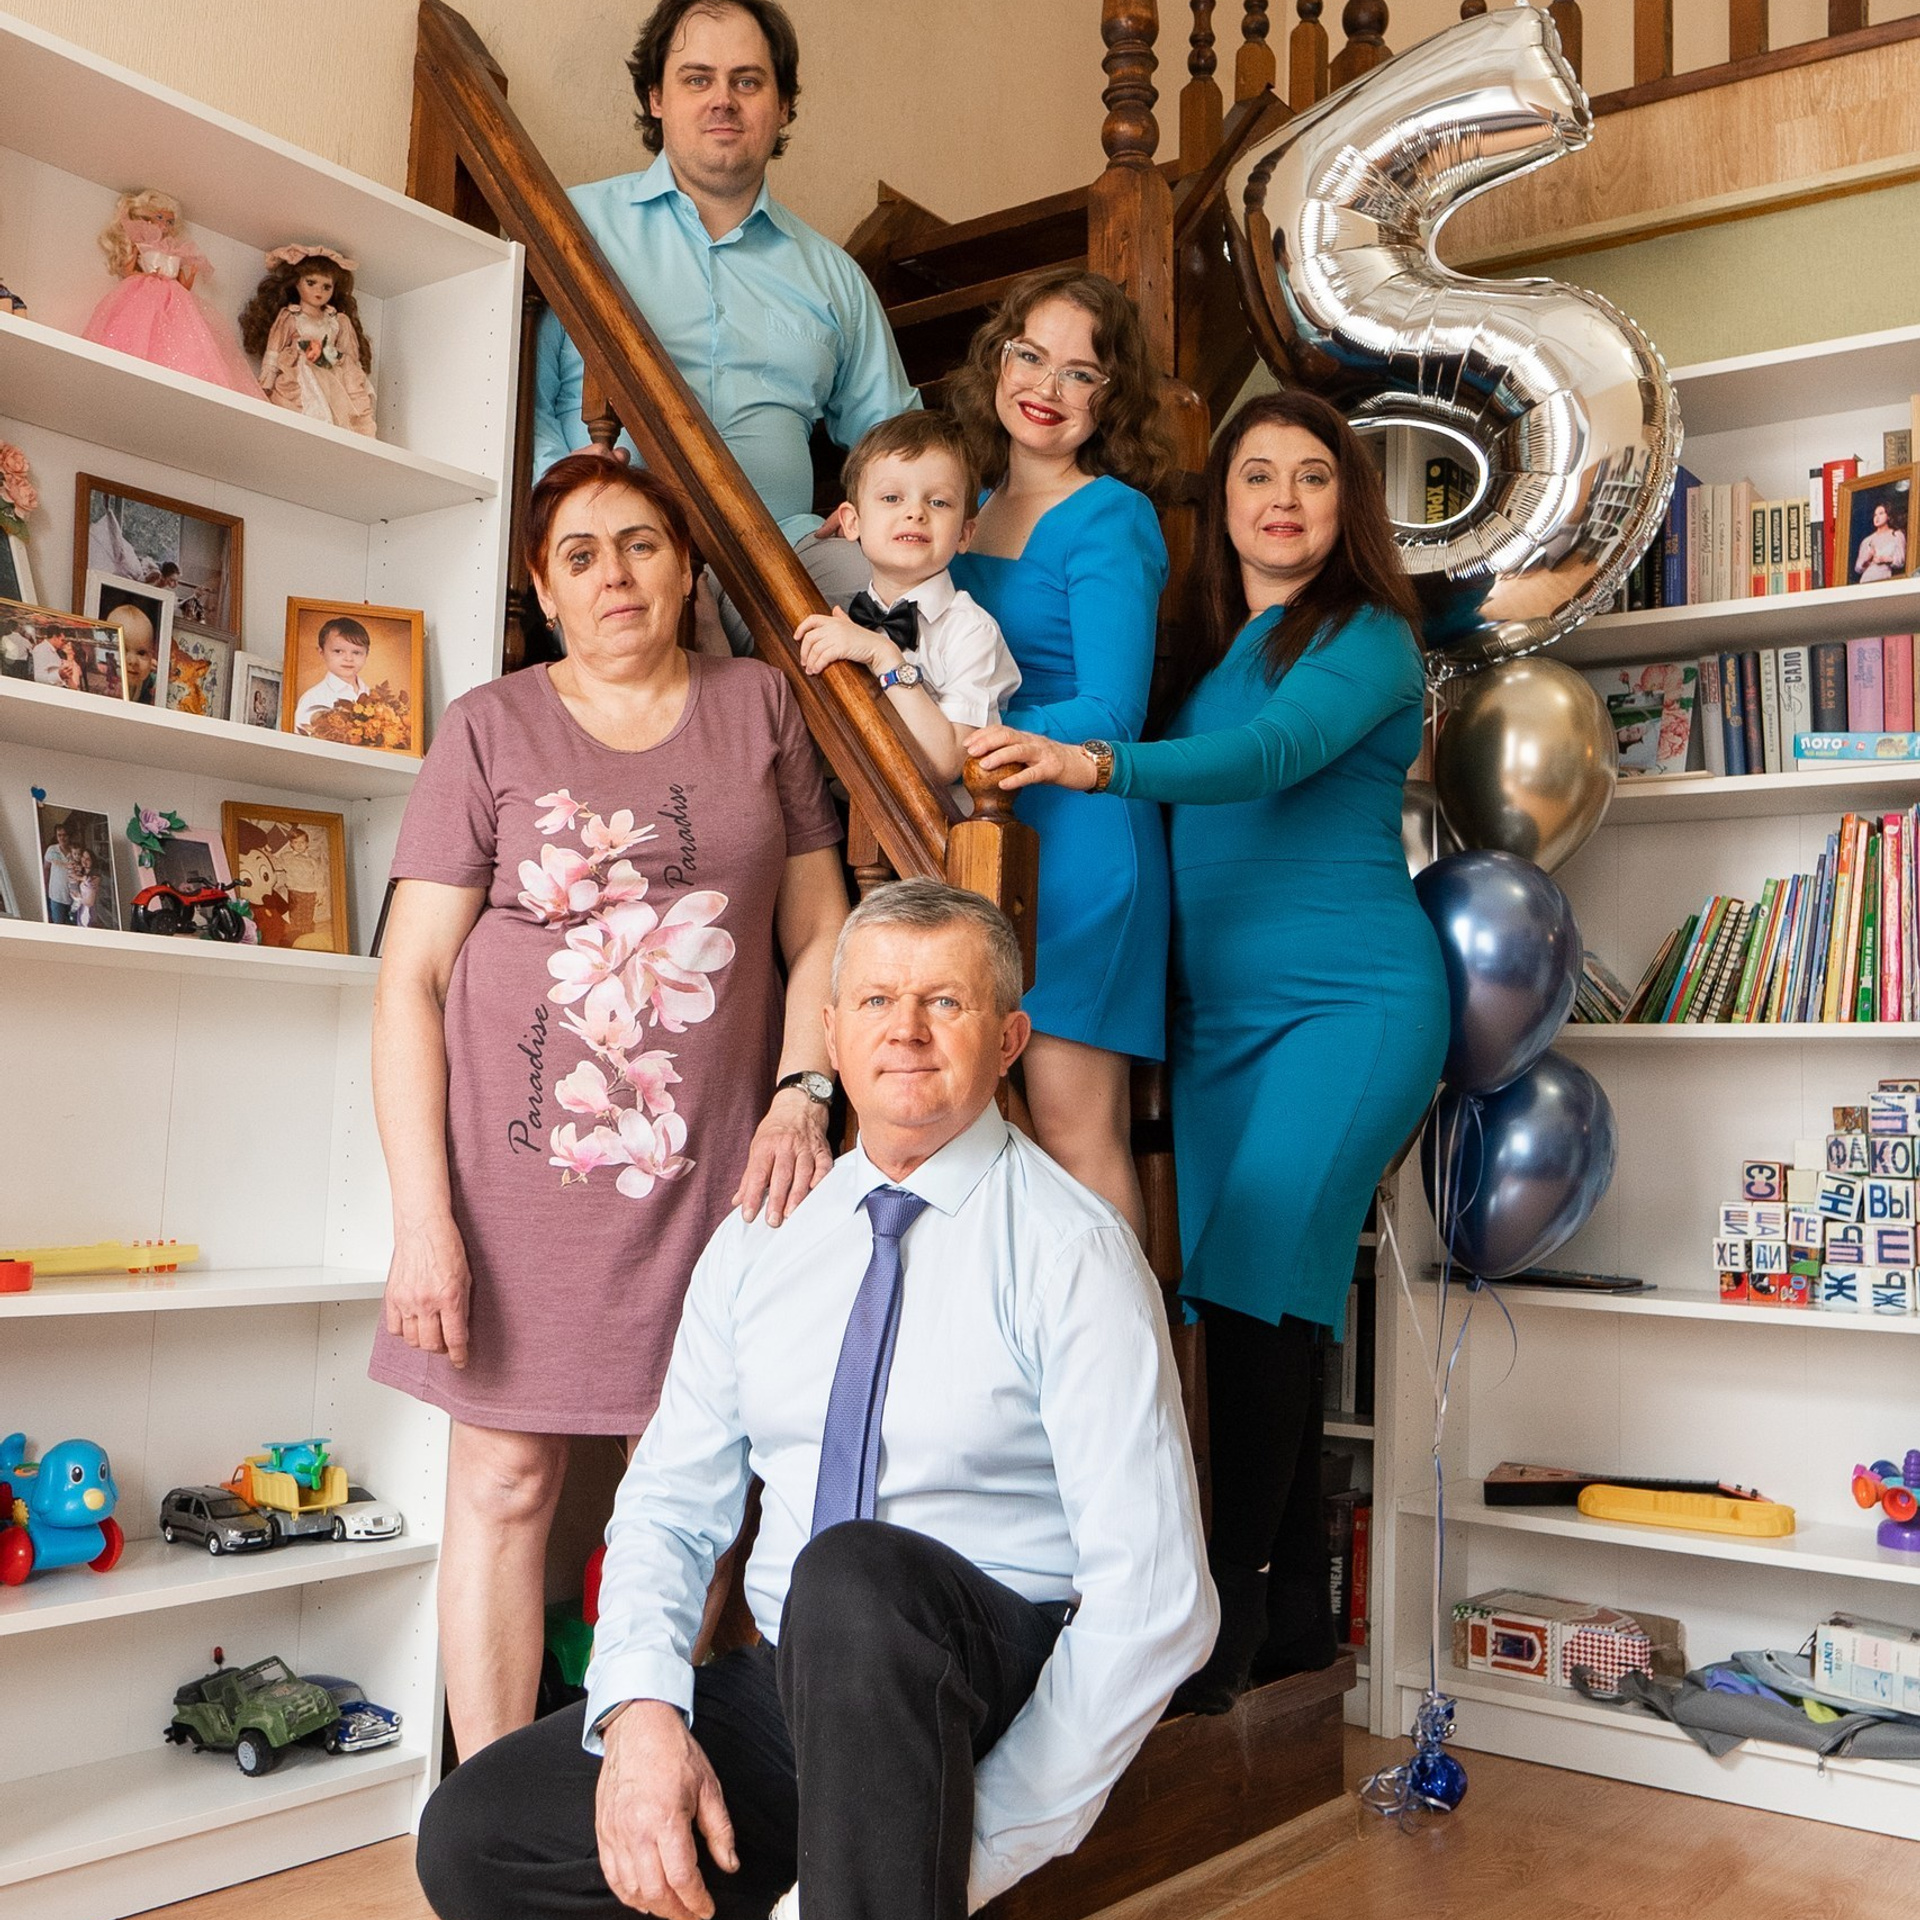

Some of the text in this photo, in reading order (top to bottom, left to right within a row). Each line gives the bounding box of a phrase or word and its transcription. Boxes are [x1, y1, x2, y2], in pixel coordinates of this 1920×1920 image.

[1783, 651, 1802, 683] САЛО
[1826, 653, 1836, 709] НОРМА
[658, 783, 696, 889] Paradise
[507, 1004, 550, 1155] Paradise
[1870, 1140, 1910, 1174] КО
[1819, 1174, 1857, 1218] НЫ
[1869, 1184, 1911, 1219] ВЫ
[1716, 1242, 1740, 1267] ХЕ
[1823, 1270, 1858, 1303] Ж
[1823, 1641, 1834, 1675] UNIT
